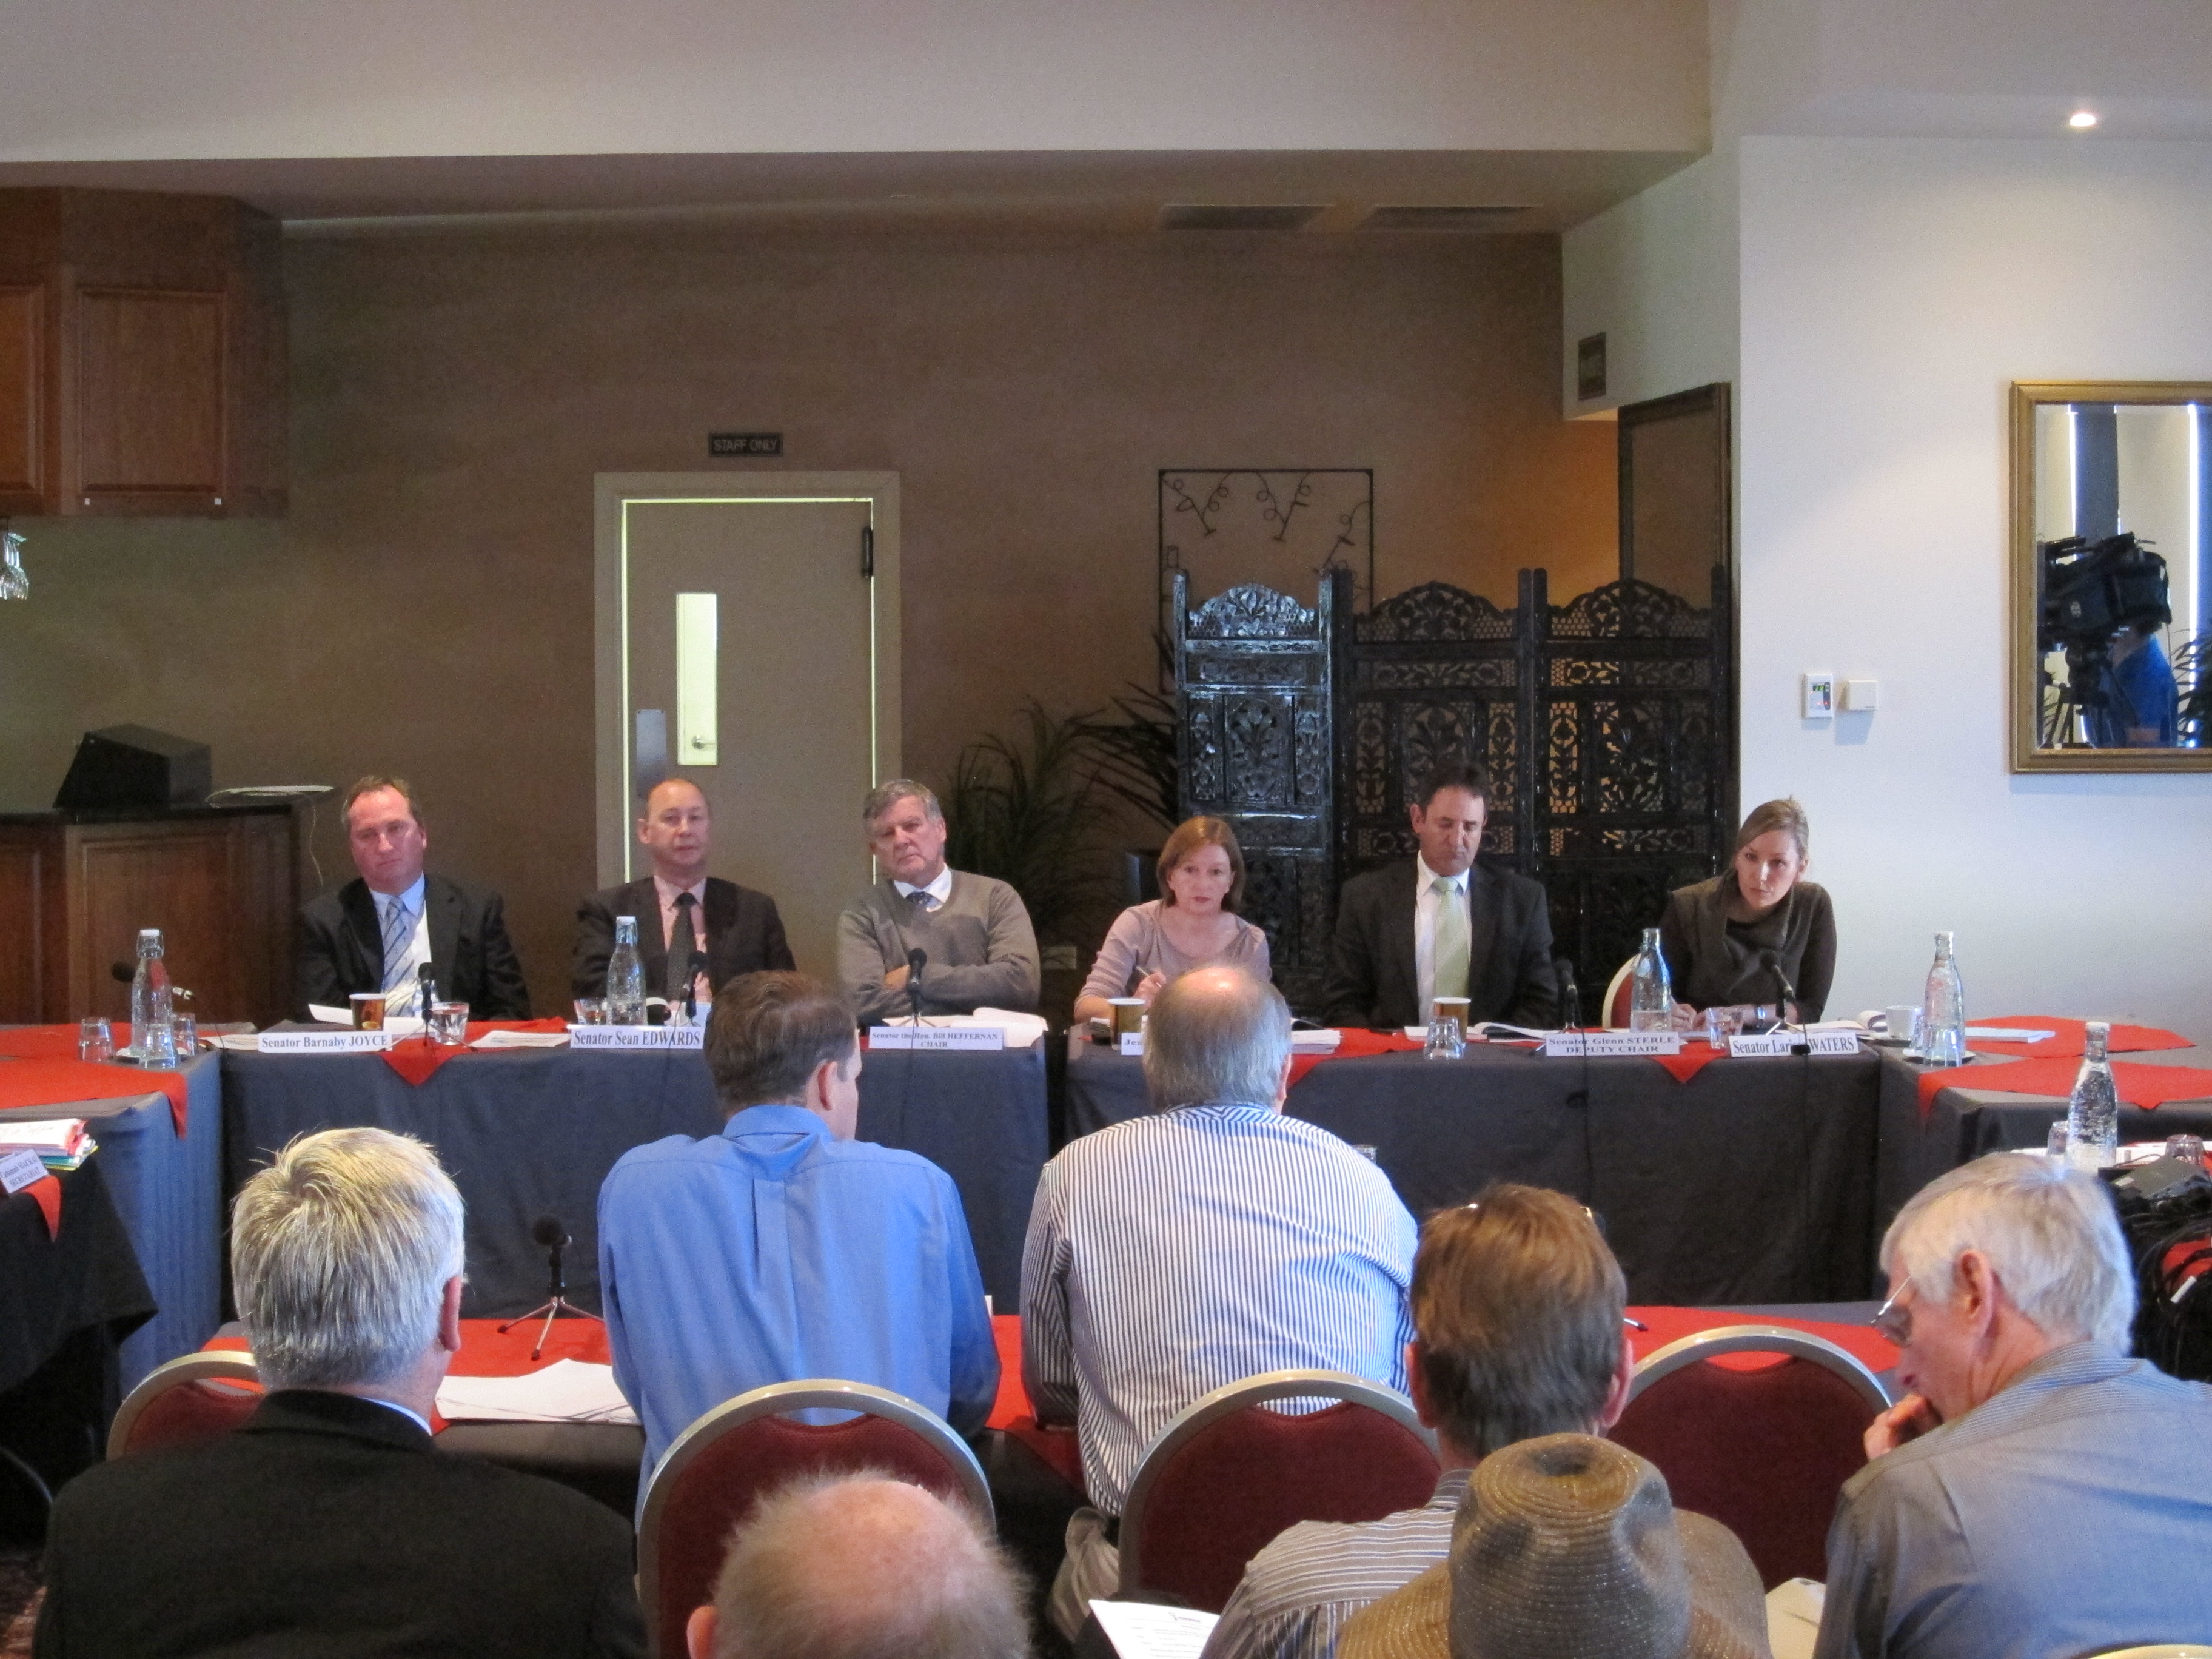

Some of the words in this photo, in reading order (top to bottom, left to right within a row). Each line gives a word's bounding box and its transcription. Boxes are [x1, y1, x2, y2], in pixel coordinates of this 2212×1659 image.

[713, 439, 746, 451] STAFF
[749, 439, 777, 451] ONLY
[261, 1037, 300, 1048] Senator
[304, 1036, 346, 1049] Barnaby
[349, 1035, 388, 1047] JOYCE
[574, 1031, 613, 1045] Senator
[615, 1031, 638, 1045] Sean
[642, 1031, 700, 1046] EDWARDS
[1732, 1040, 1770, 1054] Senator
[1808, 1037, 1855, 1052] WATERS
